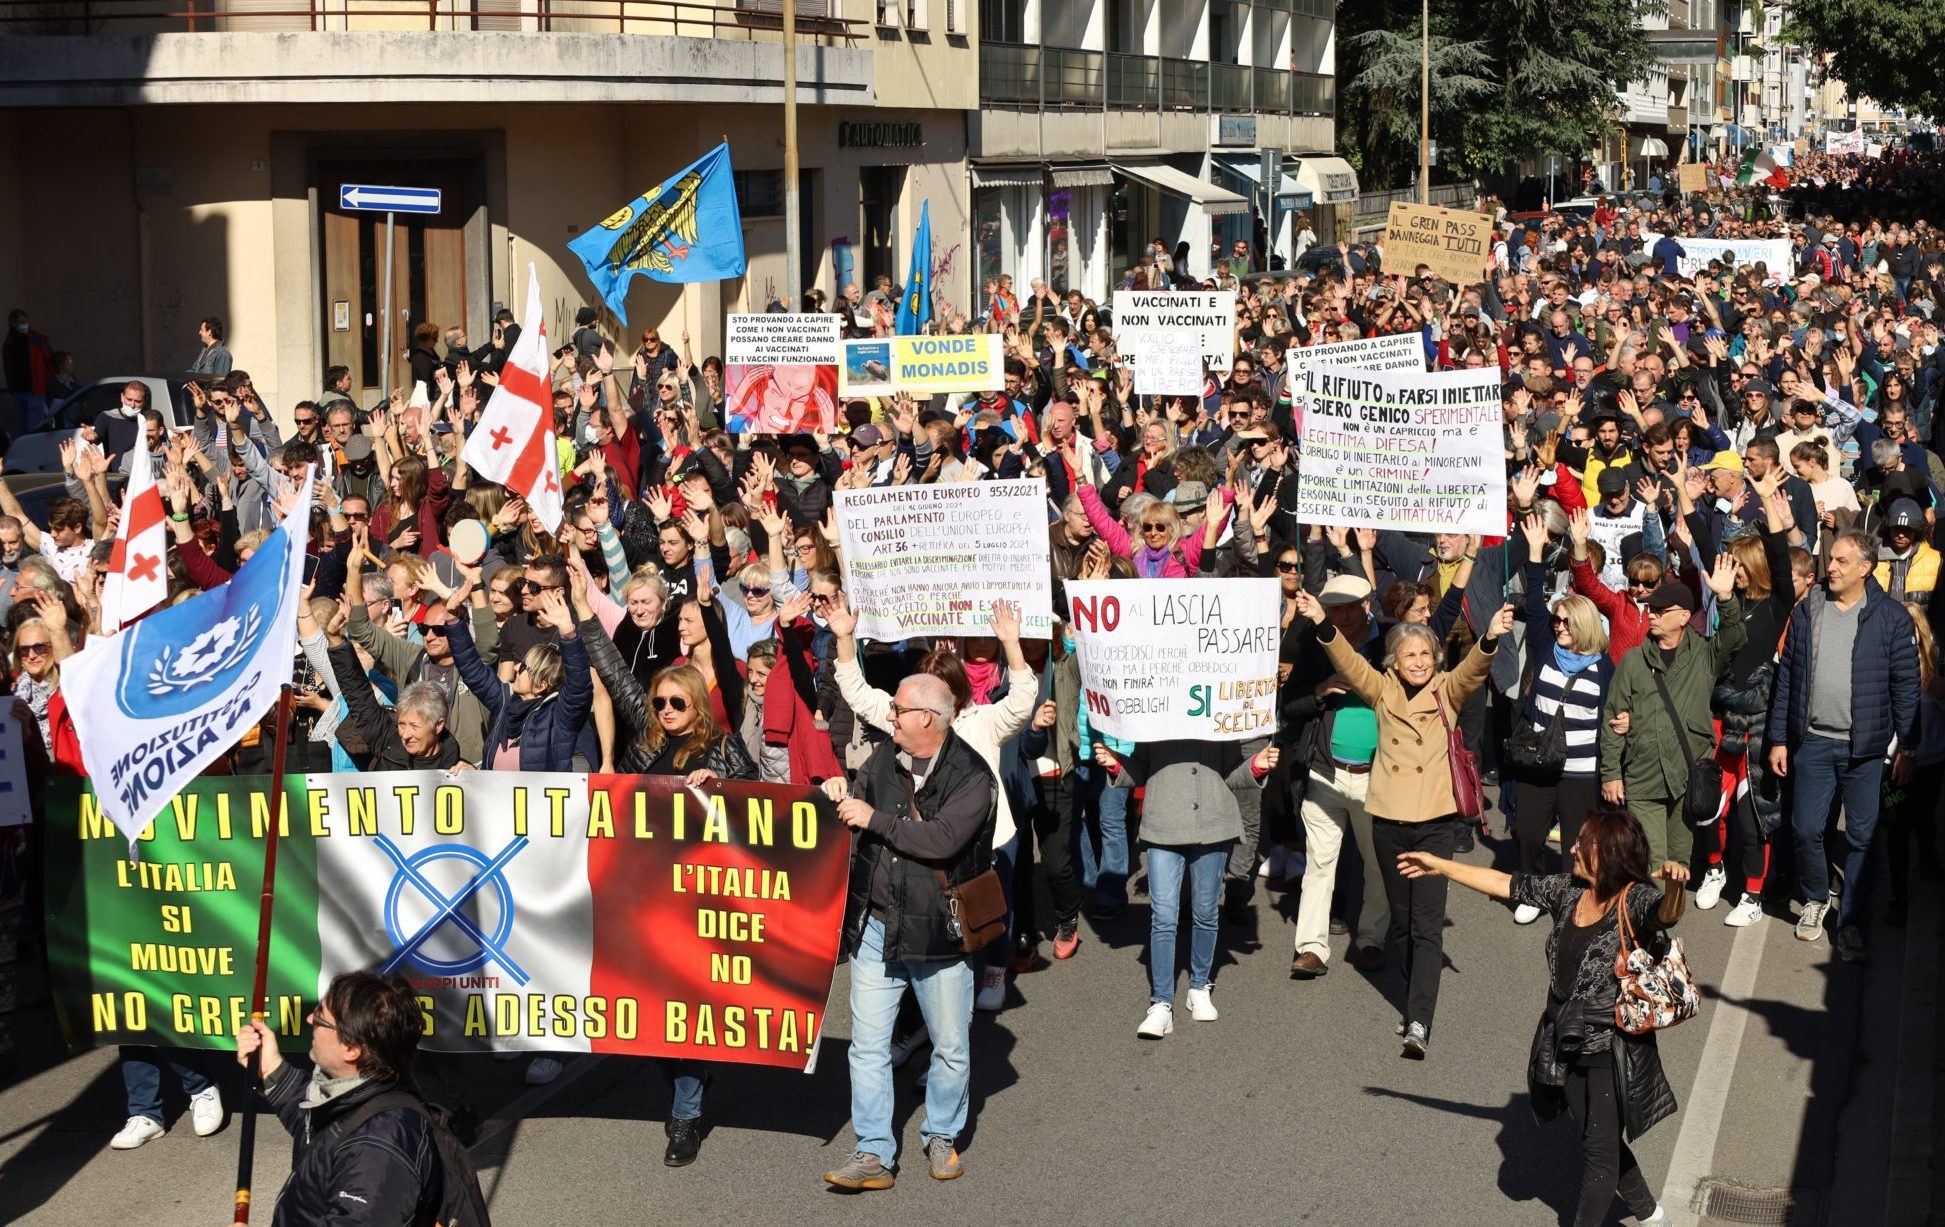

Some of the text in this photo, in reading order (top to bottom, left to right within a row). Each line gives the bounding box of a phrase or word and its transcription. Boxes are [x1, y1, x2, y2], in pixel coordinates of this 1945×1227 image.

[1392, 214, 1402, 226] IL
[1446, 220, 1477, 236] PASS
[1390, 229, 1482, 253] DANNEGGIA TUTTI
[1132, 296, 1216, 308] VACCINATI E
[1122, 315, 1226, 326] NON VACCINATI
[911, 338, 976, 355] VONDE
[1293, 351, 1312, 360] STO
[1315, 342, 1367, 356] PROVANDO
[1380, 336, 1416, 348] CAPIRE
[1336, 356, 1357, 365] NON
[1360, 348, 1412, 362] VACCINATI
[901, 361, 989, 378] MONADIS
[1385, 359, 1419, 370] DANNO
[1306, 370, 1316, 393] IL
[1322, 375, 1383, 402] RIFIUTO
[1386, 393, 1395, 404] DI
[1400, 388, 1438, 405] FARSI
[1313, 398, 1500, 425] SIERO GENICO SPERIMENTALE
[1343, 422, 1360, 432] NON
[1364, 423, 1370, 433] è
[1373, 426, 1385, 434] UN
[1389, 426, 1436, 437] CAPRICCIO
[1442, 427, 1463, 437] ma
[1304, 428, 1437, 454] LEGITTIMA DIFESA!
[1343, 451, 1351, 461] DI
[1354, 452, 1408, 467] INIETTARLO
[1425, 456, 1481, 468] MINORENNI
[1349, 467, 1362, 476] un
[1368, 467, 1430, 481] CRIMINE!
[845, 484, 1038, 507] REGOLAMENTO EUROPEO 953/2021
[1344, 479, 1488, 495] LIMITAZIONI delle LIBERTÀ
[1354, 493, 1362, 504] in
[1366, 495, 1408, 507] SEGUITO
[1414, 496, 1423, 507] al
[1429, 497, 1470, 508] RIFIUTO
[1477, 498, 1488, 510] di
[848, 519, 868, 530] DEL
[874, 512, 945, 527] PARLAMENTO
[951, 509, 1002, 522] EUROPEO
[1391, 508, 1465, 524] DITTATURA!
[861, 528, 905, 542] CONSILIO
[986, 523, 1030, 534] EUROPEA
[895, 542, 908, 552] 36
[892, 600, 972, 615] SCELTO DI NON
[1073, 594, 1222, 633] NO AL LASCIA
[897, 612, 964, 628] VACCINATE
[1198, 626, 1278, 654] PASSARE
[1104, 645, 1153, 661] OBBEDISCI
[1123, 664, 1137, 675] MA
[1188, 662, 1237, 674] OBBEDISCI
[1103, 675, 1179, 690] NON FINIRÀ MAI
[1086, 688, 1169, 716] NO OBBLIGHI
[1187, 685, 1212, 717] SI
[1214, 708, 1273, 733] SCELTA
[78, 784, 818, 850] MVIMENTO ITALIANO
[116, 860, 238, 892] L'ITALIA
[672, 862, 792, 901] L'ITALIA
[161, 904, 192, 934] SI
[698, 908, 766, 944] DICE
[130, 943, 234, 976] MUOVE
[710, 952, 752, 986] NO
[460, 976, 500, 989] UNITI
[92, 991, 147, 1033] NO
[464, 993, 638, 1041] ADESSO
[665, 1000, 816, 1056] BASTA!
